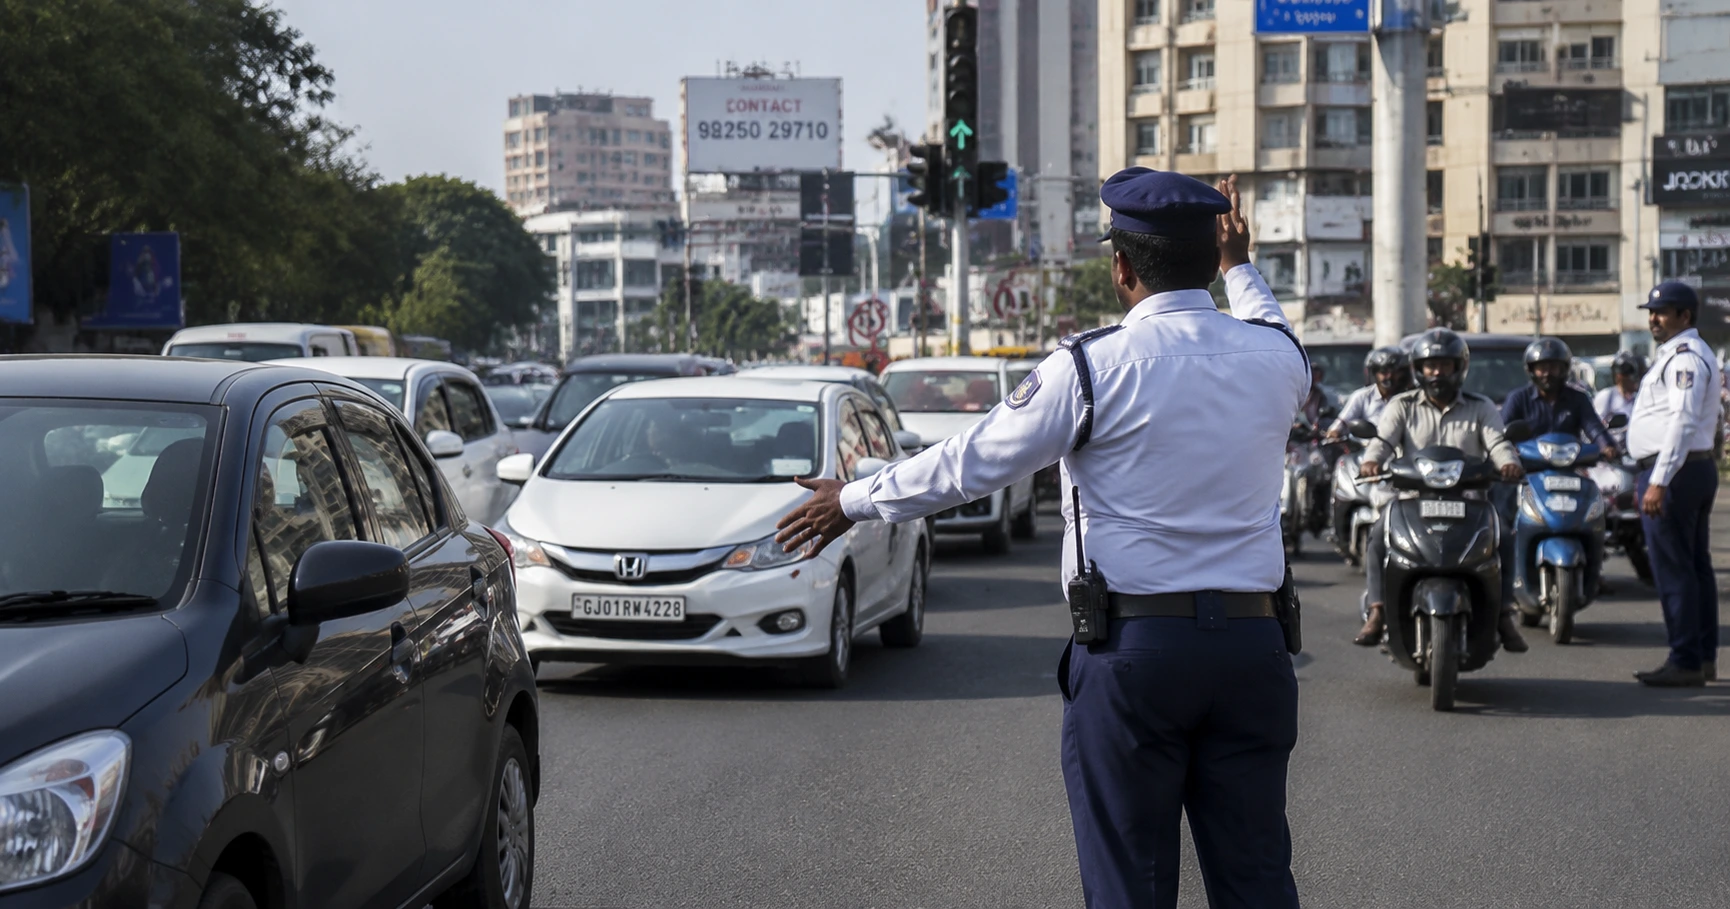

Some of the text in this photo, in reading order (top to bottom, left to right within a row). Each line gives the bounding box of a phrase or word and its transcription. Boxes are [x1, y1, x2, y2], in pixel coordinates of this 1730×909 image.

[726, 98, 802, 113] CONTACT
[698, 120, 828, 139] 98250 29710
